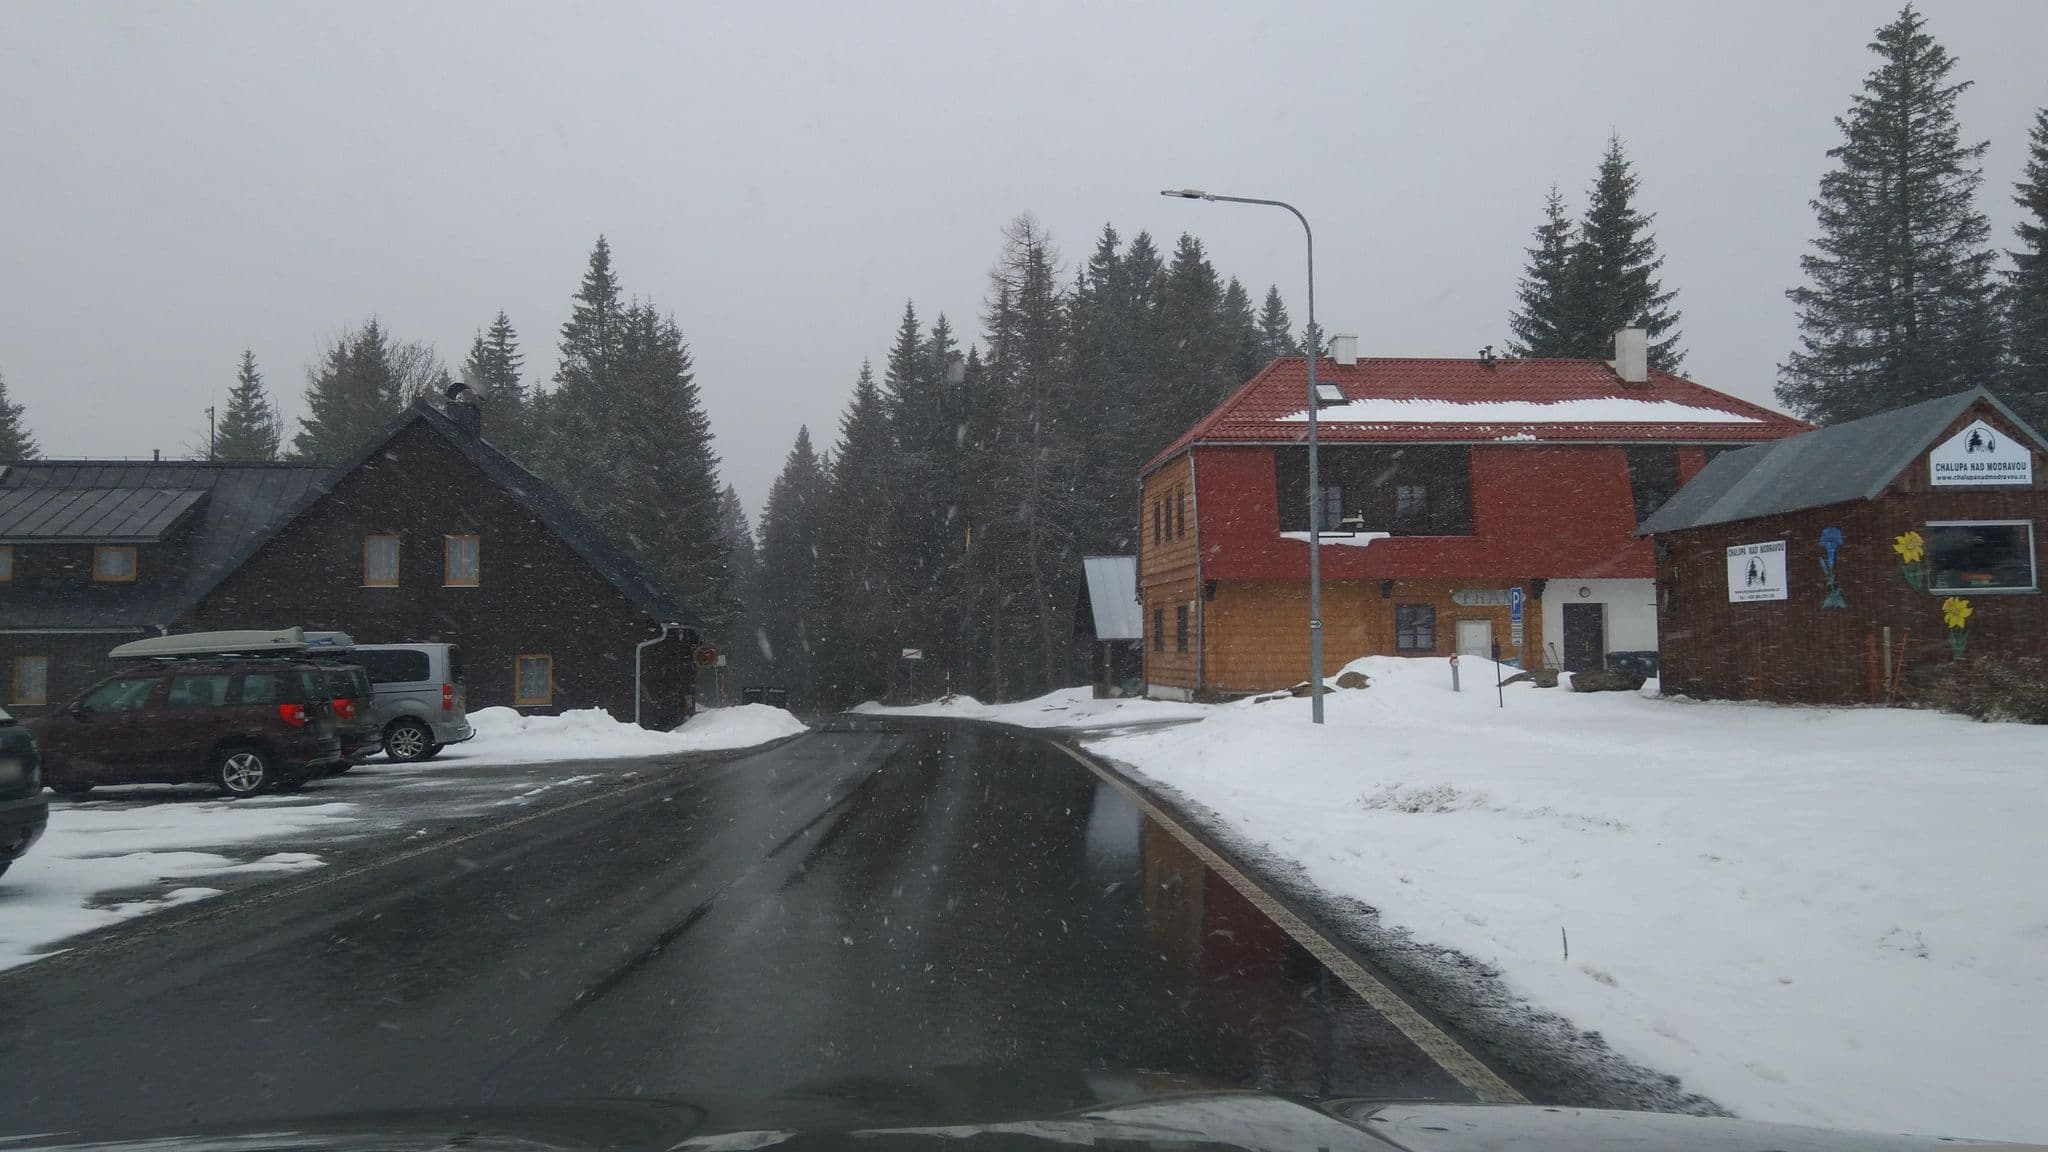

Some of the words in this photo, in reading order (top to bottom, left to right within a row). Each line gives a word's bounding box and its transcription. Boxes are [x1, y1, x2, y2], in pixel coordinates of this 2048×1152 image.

[1935, 462, 1968, 472] CHALUPA
[1970, 462, 1985, 471] NAD
[1986, 461, 2027, 471] MODRAVOU
[1728, 547, 1746, 557] CHALUPA
[1749, 546, 1758, 555] NAD
[1513, 591, 1520, 611] P
